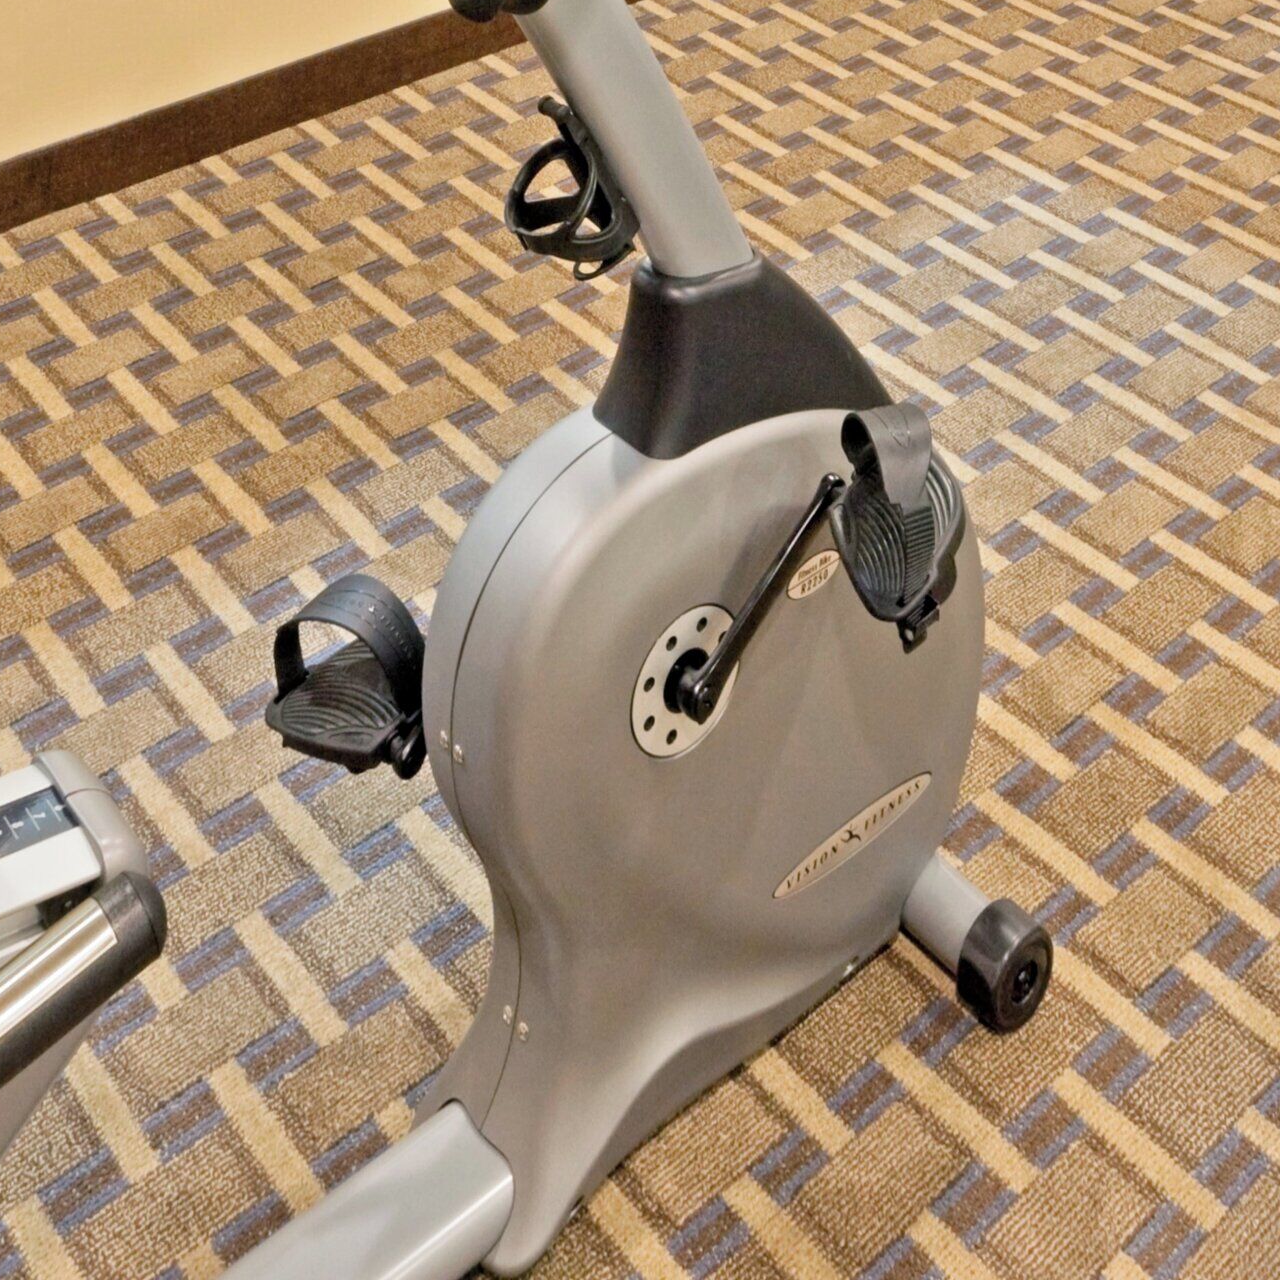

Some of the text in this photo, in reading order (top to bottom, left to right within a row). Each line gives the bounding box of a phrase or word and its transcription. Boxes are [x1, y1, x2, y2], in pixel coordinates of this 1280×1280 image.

[801, 568, 829, 595] R2250
[787, 780, 921, 889] VISION FITNESS
